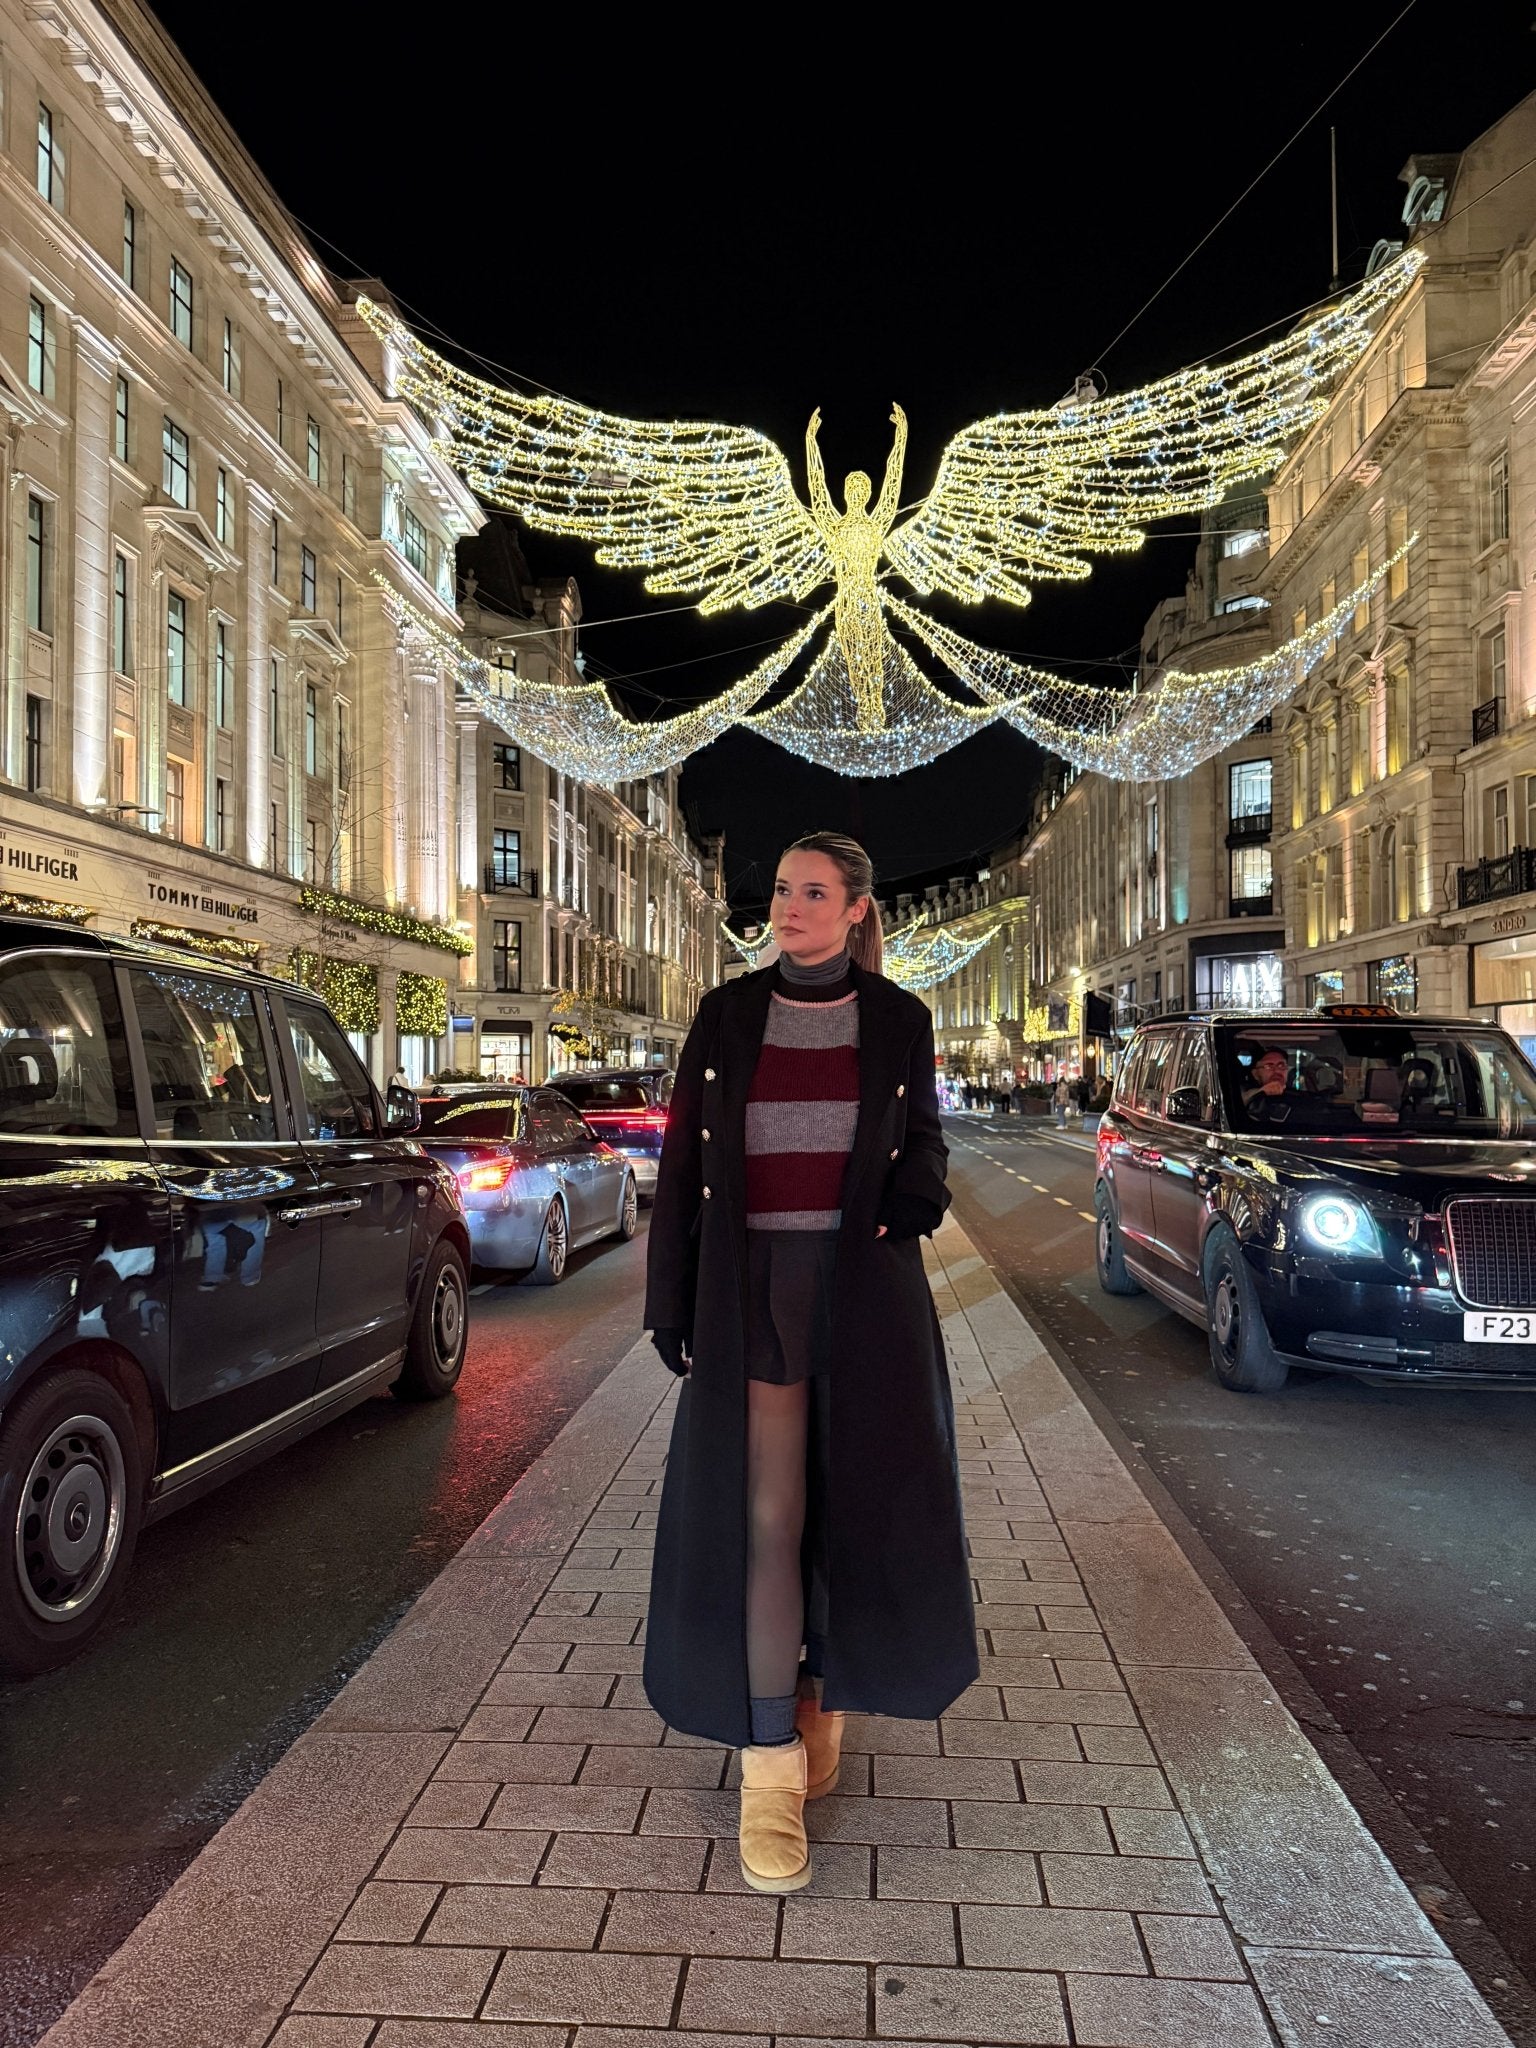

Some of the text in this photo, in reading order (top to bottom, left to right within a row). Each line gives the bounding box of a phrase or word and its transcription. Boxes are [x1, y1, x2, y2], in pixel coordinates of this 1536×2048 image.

[8, 848, 79, 881] HILFIGER
[148, 883, 199, 909] TOMMY
[1491, 915, 1526, 934] SANDRO
[497, 1006, 520, 1015] TUMI
[1336, 1008, 1392, 1017] TAXI
[1483, 1316, 1531, 1338] F23
